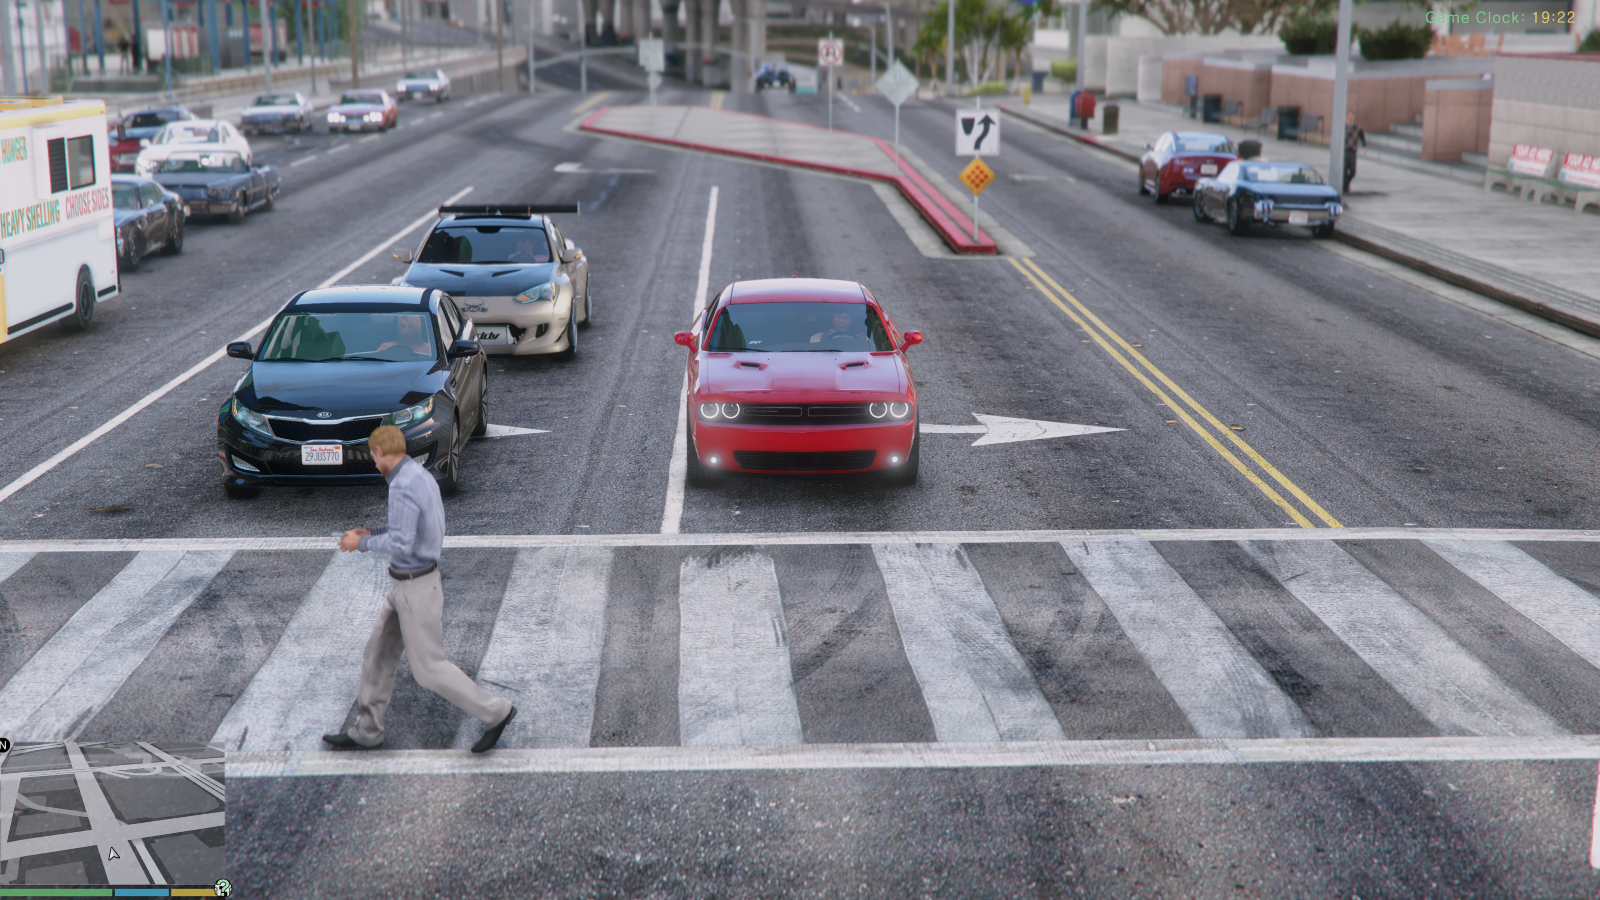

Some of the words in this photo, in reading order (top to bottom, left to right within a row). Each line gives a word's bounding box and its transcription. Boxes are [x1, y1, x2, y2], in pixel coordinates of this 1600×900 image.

[1, 136, 28, 164] HUNGER
[65, 191, 92, 220] CHOOSE
[92, 186, 110, 213] SIDES
[0, 208, 25, 239] HEAVY
[26, 199, 60, 232] SHELLING
[305, 452, 339, 461] 29JUS770
